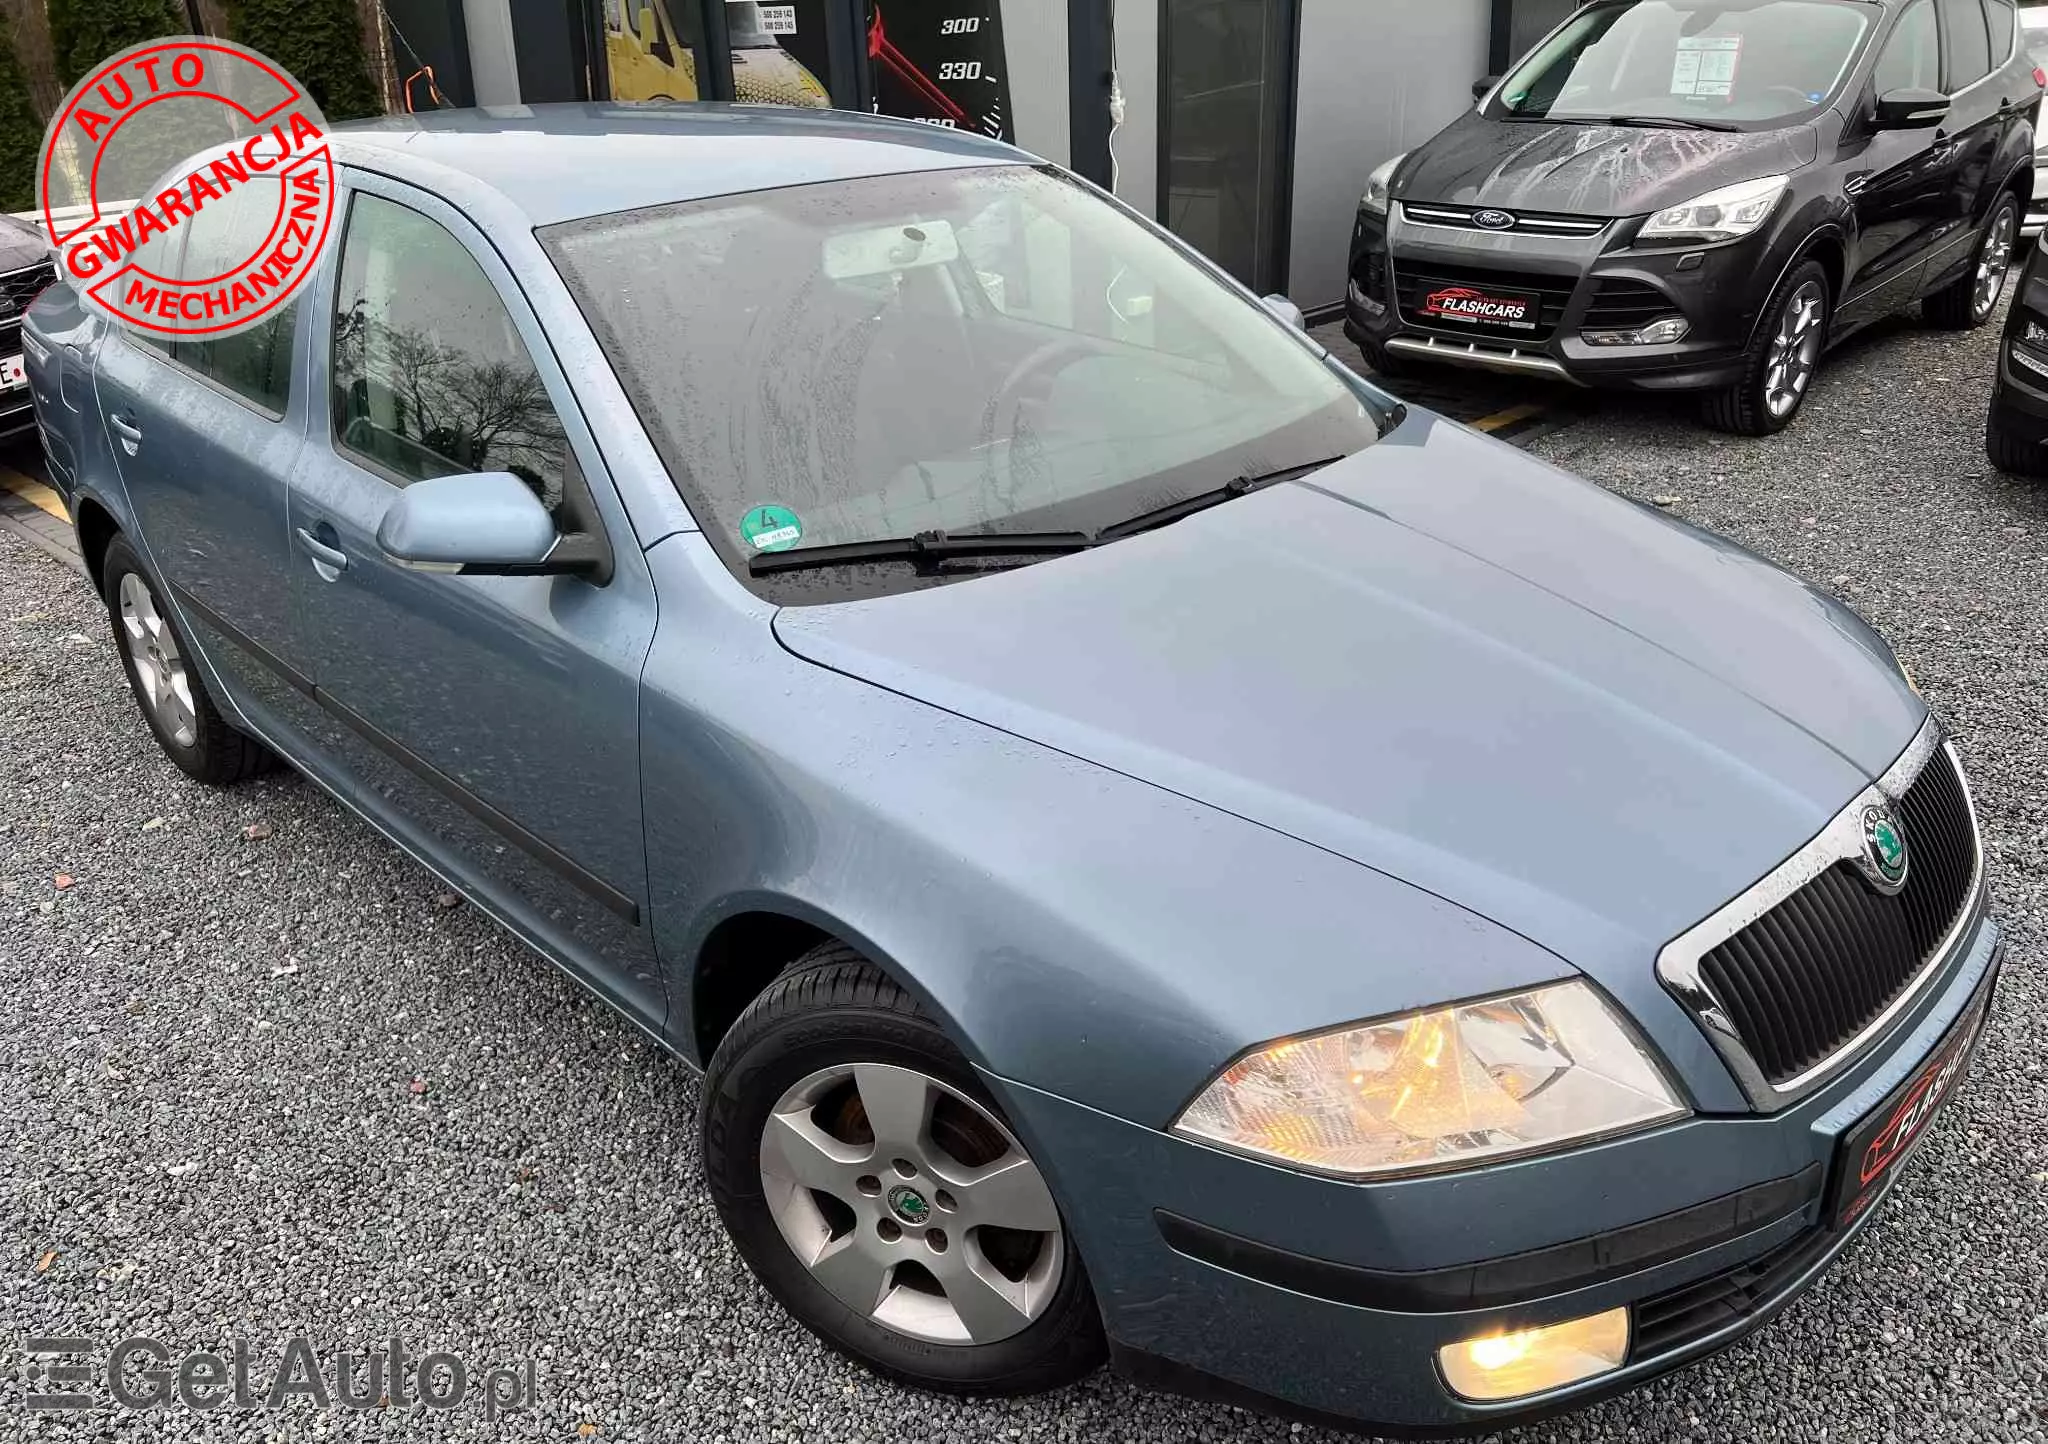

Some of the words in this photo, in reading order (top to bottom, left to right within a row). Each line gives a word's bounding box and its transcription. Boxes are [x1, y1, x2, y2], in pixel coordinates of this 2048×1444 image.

[941, 17, 979, 34] 300
[939, 62, 981, 80] 330
[1443, 298, 1525, 318] FLASHCARS
[762, 509, 779, 528] 4
